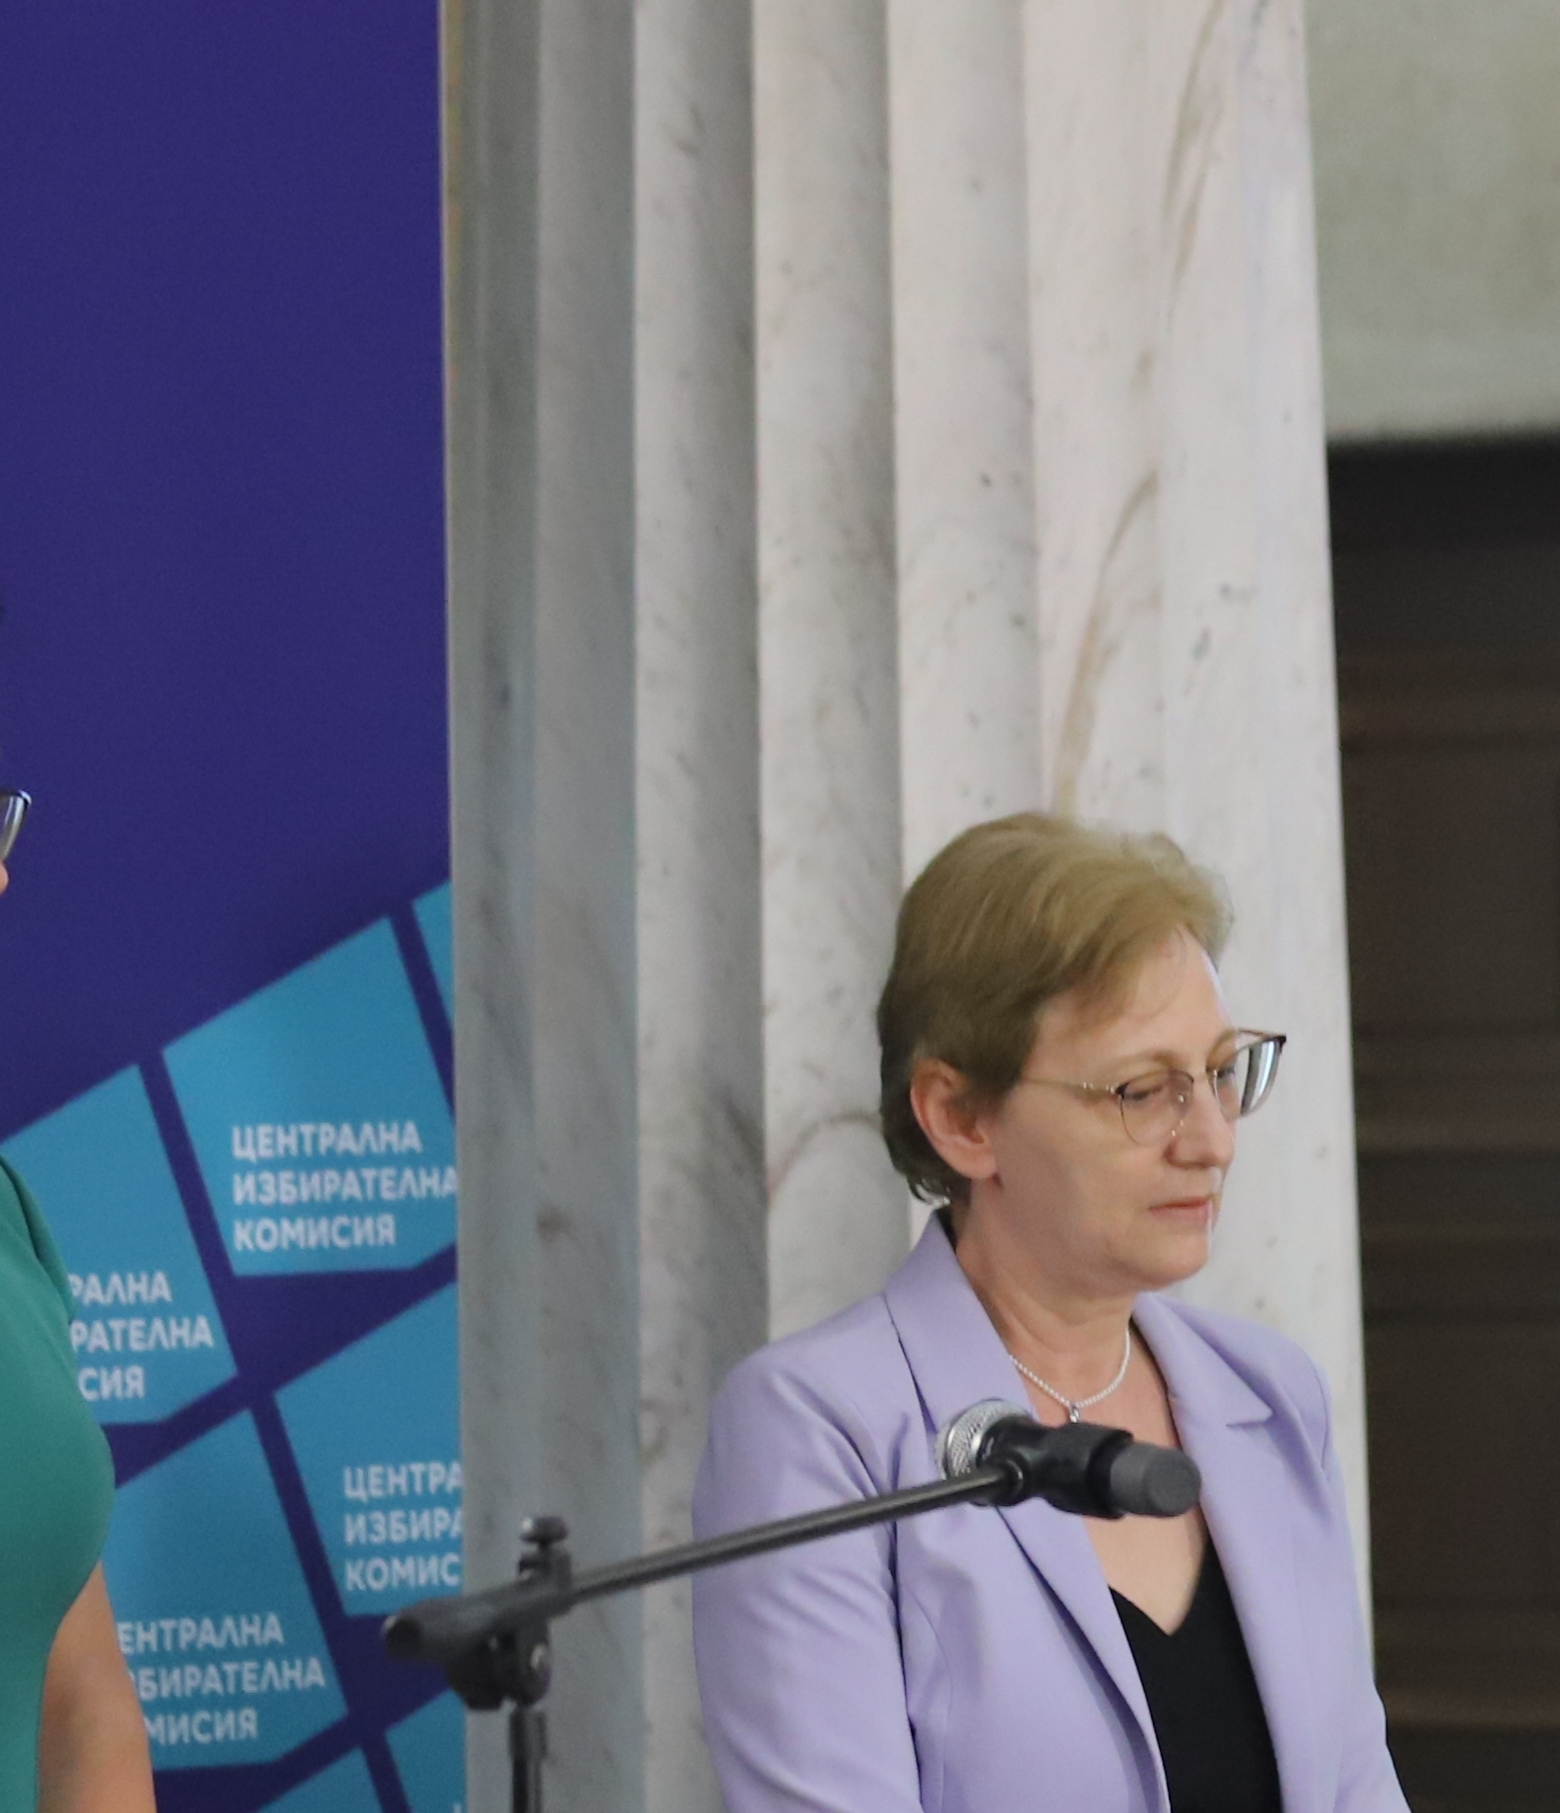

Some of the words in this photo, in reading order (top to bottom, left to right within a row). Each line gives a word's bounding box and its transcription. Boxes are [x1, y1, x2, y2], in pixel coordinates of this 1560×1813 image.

[231, 1120, 423, 1163] ЦЕНТРАЛНА
[232, 1165, 458, 1207] ИЗБИРАТЕЛНА
[233, 1213, 397, 1253] КОМИСИЯ
[128, 1656, 326, 1701] БИРАТЕЛНА
